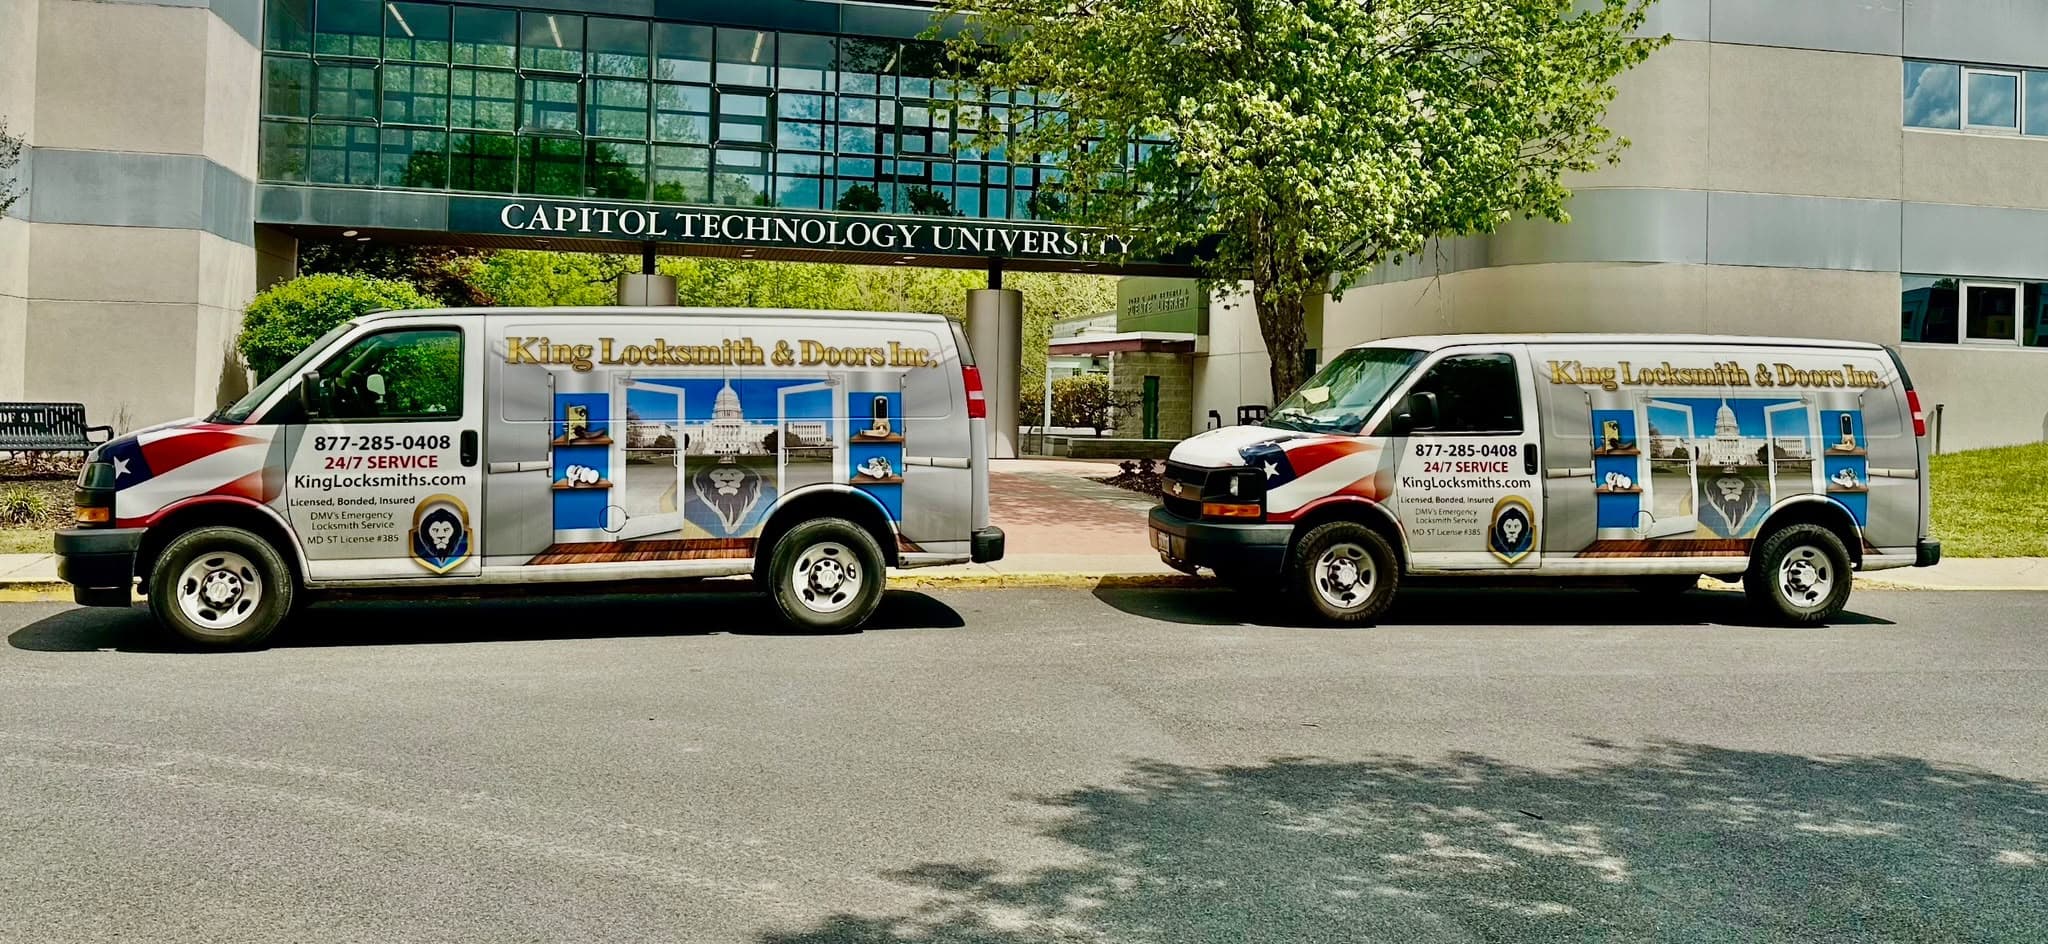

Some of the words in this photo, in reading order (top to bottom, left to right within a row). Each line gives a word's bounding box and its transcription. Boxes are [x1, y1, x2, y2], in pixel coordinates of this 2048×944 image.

[500, 203, 668, 237] CAPITOL
[675, 211, 922, 249] TECHNOLOGY
[1157, 295, 1190, 312] LIBRARY
[505, 336, 593, 372] King
[598, 337, 765, 366] Locksmith
[770, 339, 795, 366] &
[798, 339, 886, 367] Doors
[1547, 360, 1618, 391] King
[1618, 361, 1751, 386] Locksmith
[1754, 362, 1774, 387] &
[1773, 362, 1845, 388] Doors
[314, 435, 451, 451] 877-285-0408
[1415, 444, 1518, 457] 877-285-0408
[324, 456, 363, 470] 24/7
[367, 455, 438, 469] SERVICE
[1424, 462, 1452, 473] 24/7
[1456, 461, 1509, 473] SERVICE
[294, 473, 466, 491] KingLocksmiths.com
[1402, 476, 1531, 490] KingLocksmiths.com
[290, 498, 335, 507] Licensed,
[337, 497, 377, 506] Bonded,
[379, 496, 415, 505] Insured
[1400, 496, 1434, 504] Licensed,
[1435, 496, 1466, 504] Bonded,
[1467, 496, 1494, 504] Insured
[310, 512, 340, 521] DMV's
[341, 511, 394, 521] Emergency
[1415, 508, 1438, 516] DMV's
[1438, 508, 1478, 517] Emergency
[311, 521, 359, 531] Locksmith
[361, 521, 395, 530] Service
[1416, 517, 1452, 525] Locksmith
[1453, 517, 1479, 525] Service
[1436, 528, 1463, 536] License
[1464, 528, 1481, 536] #385
[340, 535, 375, 543] License
[376, 534, 400, 543] #385
